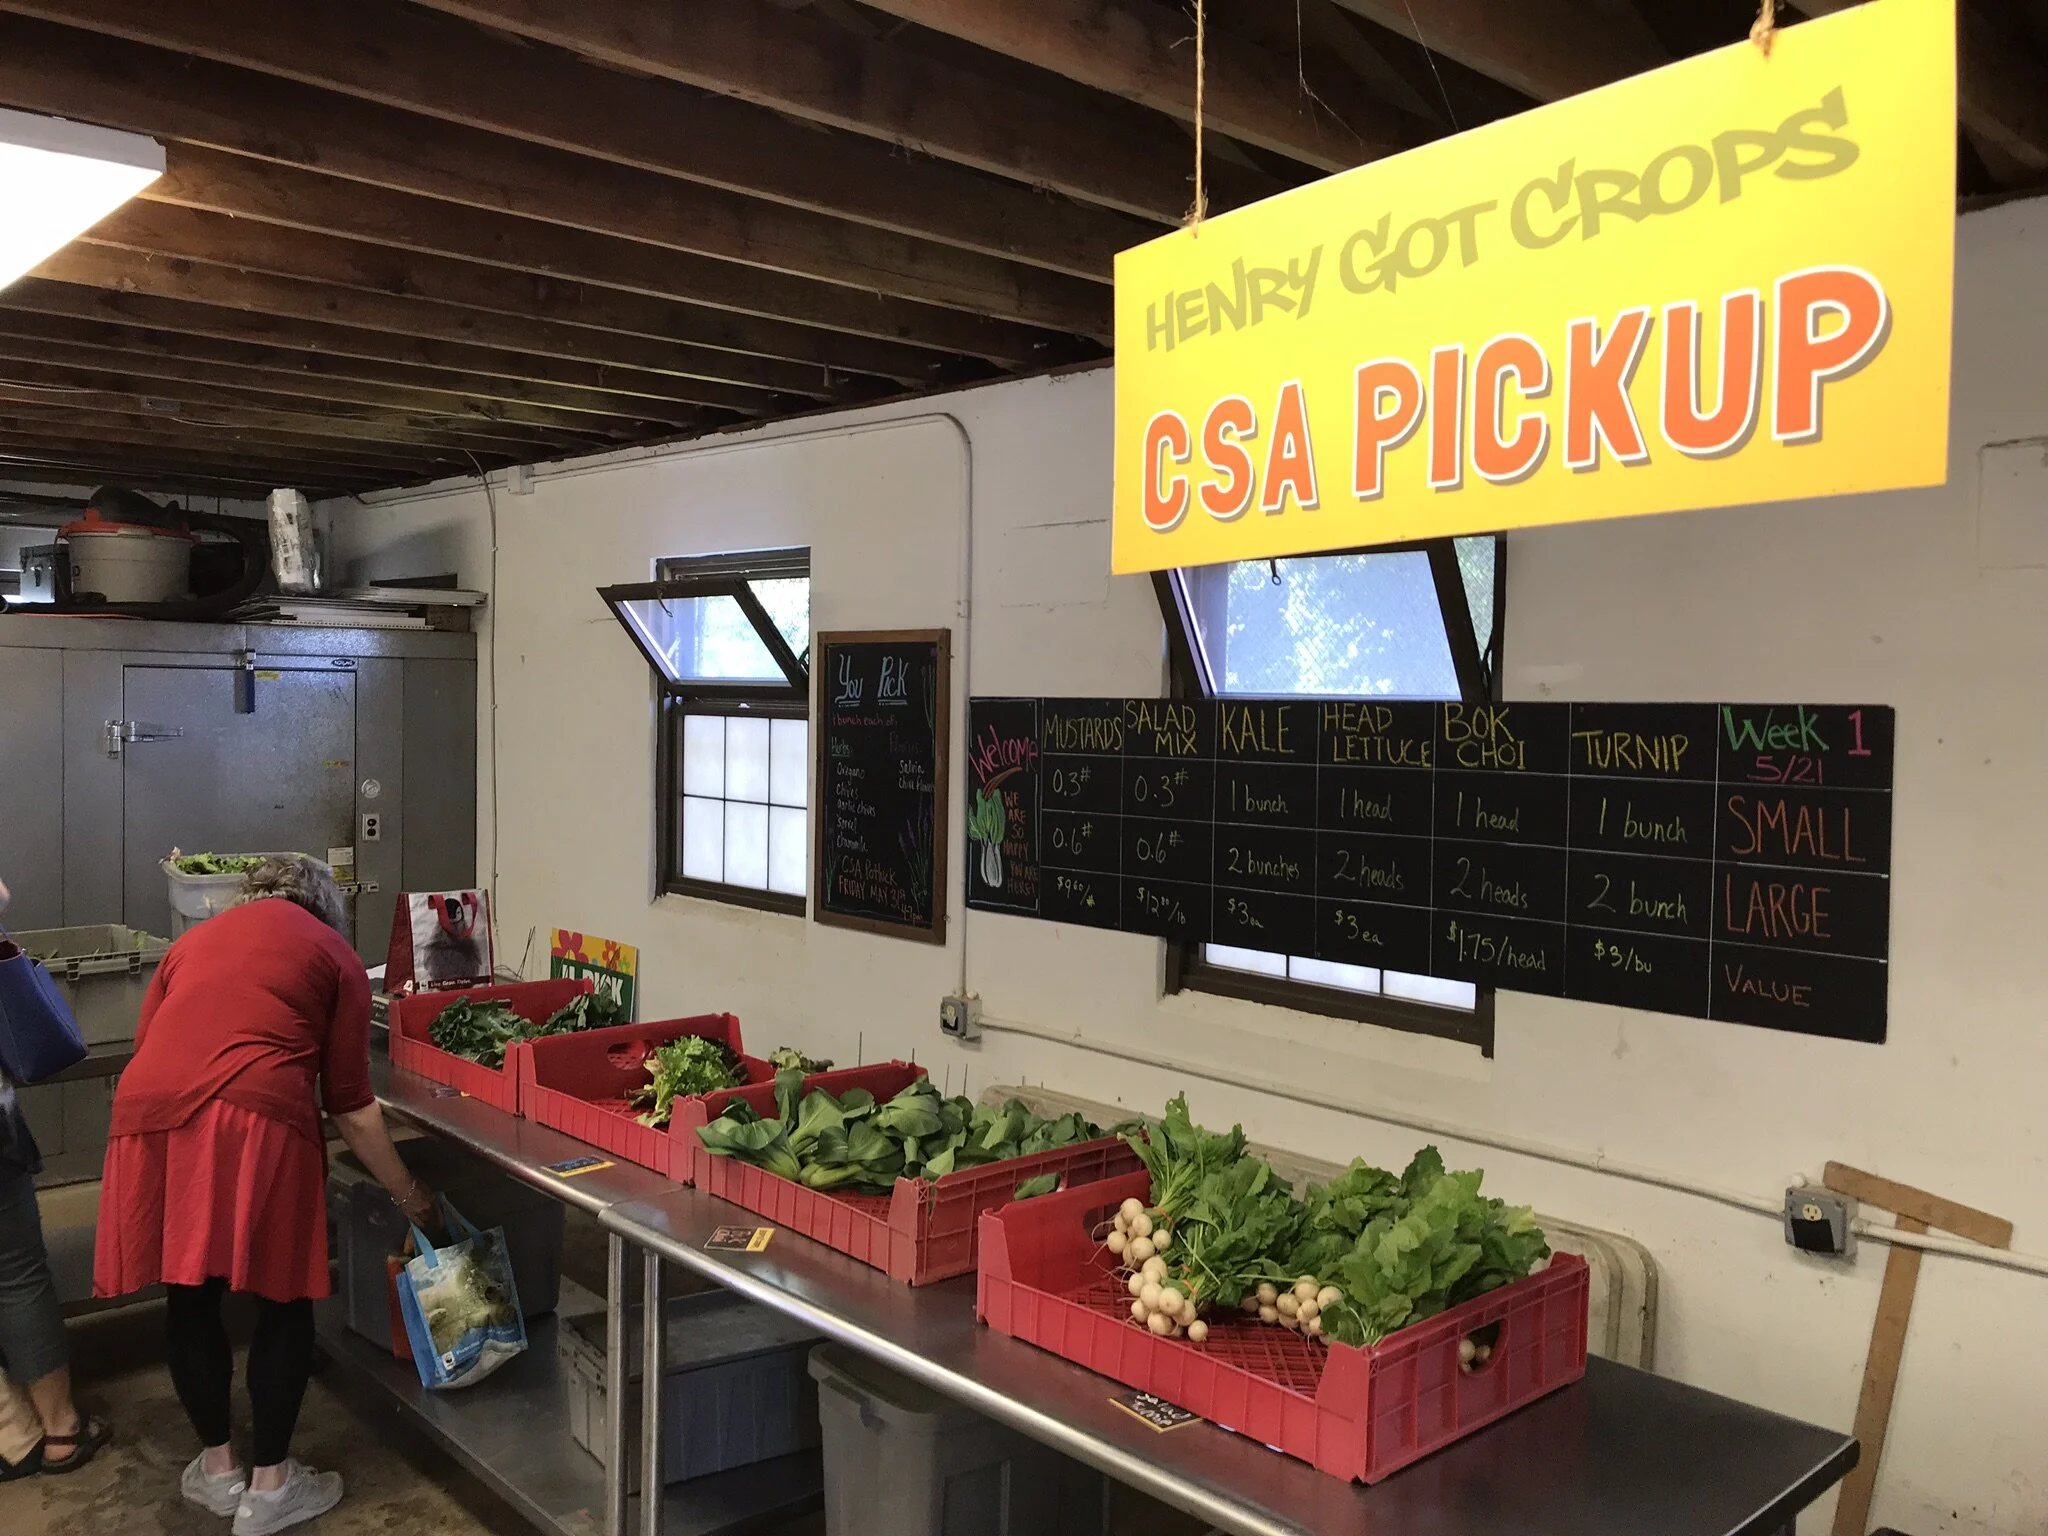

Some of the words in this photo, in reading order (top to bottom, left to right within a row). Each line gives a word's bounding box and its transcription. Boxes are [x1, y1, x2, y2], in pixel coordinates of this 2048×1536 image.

[1145, 243, 1325, 353] HENRY
[1339, 201, 1499, 296] GOT
[1510, 86, 1861, 251] CROPS
[1142, 379, 1320, 532] CSA
[1353, 264, 1892, 498] PICKUP
[1044, 713, 1123, 751] MUSTARDS
[1125, 700, 1196, 735] SALAD
[1221, 703, 1295, 755] KALE
[1323, 702, 1393, 732] HEAD
[1444, 701, 1515, 743] BOK
[1847, 709, 1871, 756] 1
[1154, 731, 1198, 756] MIX
[1333, 735, 1432, 768] LETTUCE
[1456, 740, 1527, 770] CHOI
[1572, 730, 1689, 772] TURNIP
[1747, 755, 1824, 785] 5/21
[1230, 779, 1237, 813] 1
[1244, 784, 1289, 814] bunch
[1340, 787, 1346, 819] 1
[1353, 789, 1393, 823] head
[1456, 791, 1463, 828] 1
[1475, 796, 1520, 833] head
[1599, 797, 1607, 835] 1
[1623, 801, 1689, 845] bunch
[1727, 795, 1866, 862] SMALL
[841, 855, 863, 880] CSA
[1228, 847, 1243, 875] 2
[1248, 850, 1301, 882] bunches
[1333, 850, 1356, 881] 2
[1360, 854, 1405, 890] heads
[1450, 856, 1473, 899] 2
[1480, 866, 1529, 910] heads
[1587, 873, 1617, 914] 2
[1628, 880, 1689, 925] bunch
[1725, 872, 1832, 938] LARGE
